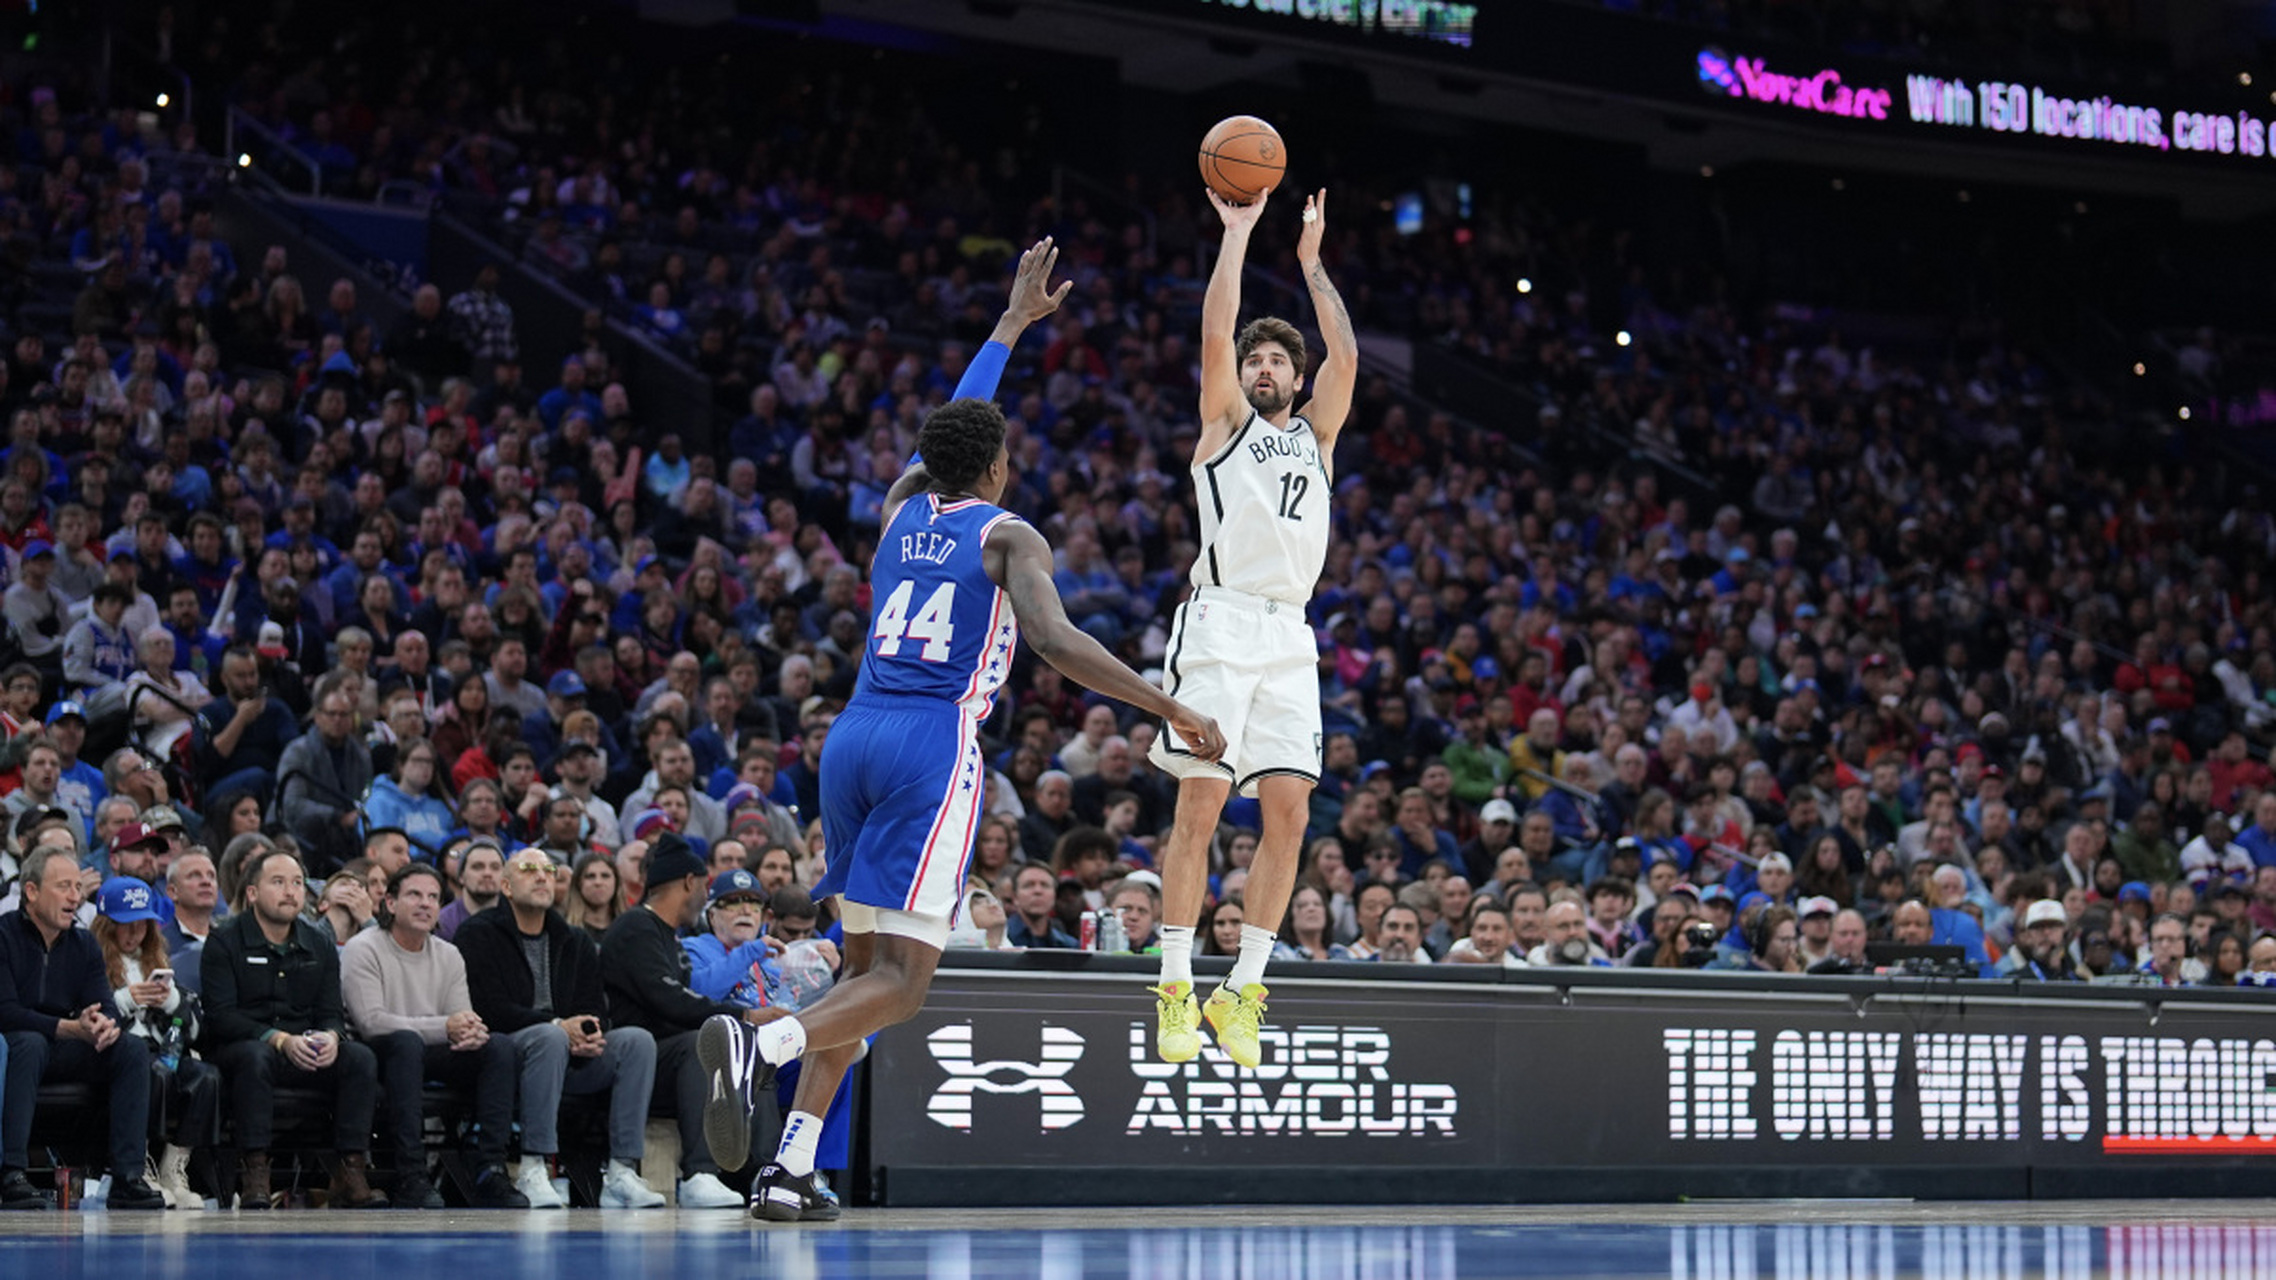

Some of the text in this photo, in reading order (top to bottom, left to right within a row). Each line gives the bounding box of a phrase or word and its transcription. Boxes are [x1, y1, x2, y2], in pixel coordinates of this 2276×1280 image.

[1729, 56, 1892, 120] NovaCare
[1906, 74, 1974, 127] With
[1978, 82, 2028, 133] 150
[2032, 86, 2170, 151] locations,
[2173, 111, 2235, 154] care
[2238, 110, 2265, 157] is
[1278, 471, 1309, 521] 12
[901, 532, 957, 565] REED
[873, 579, 957, 662] 44
[1130, 1022, 1390, 1080] UNDER
[1125, 1081, 1457, 1136] ARMOUR
[1663, 1028, 1758, 1140] THE
[1772, 1029, 1901, 1140] ONLY
[1913, 1033, 2027, 1140] WAY
[2041, 1035, 2090, 1141] IS
